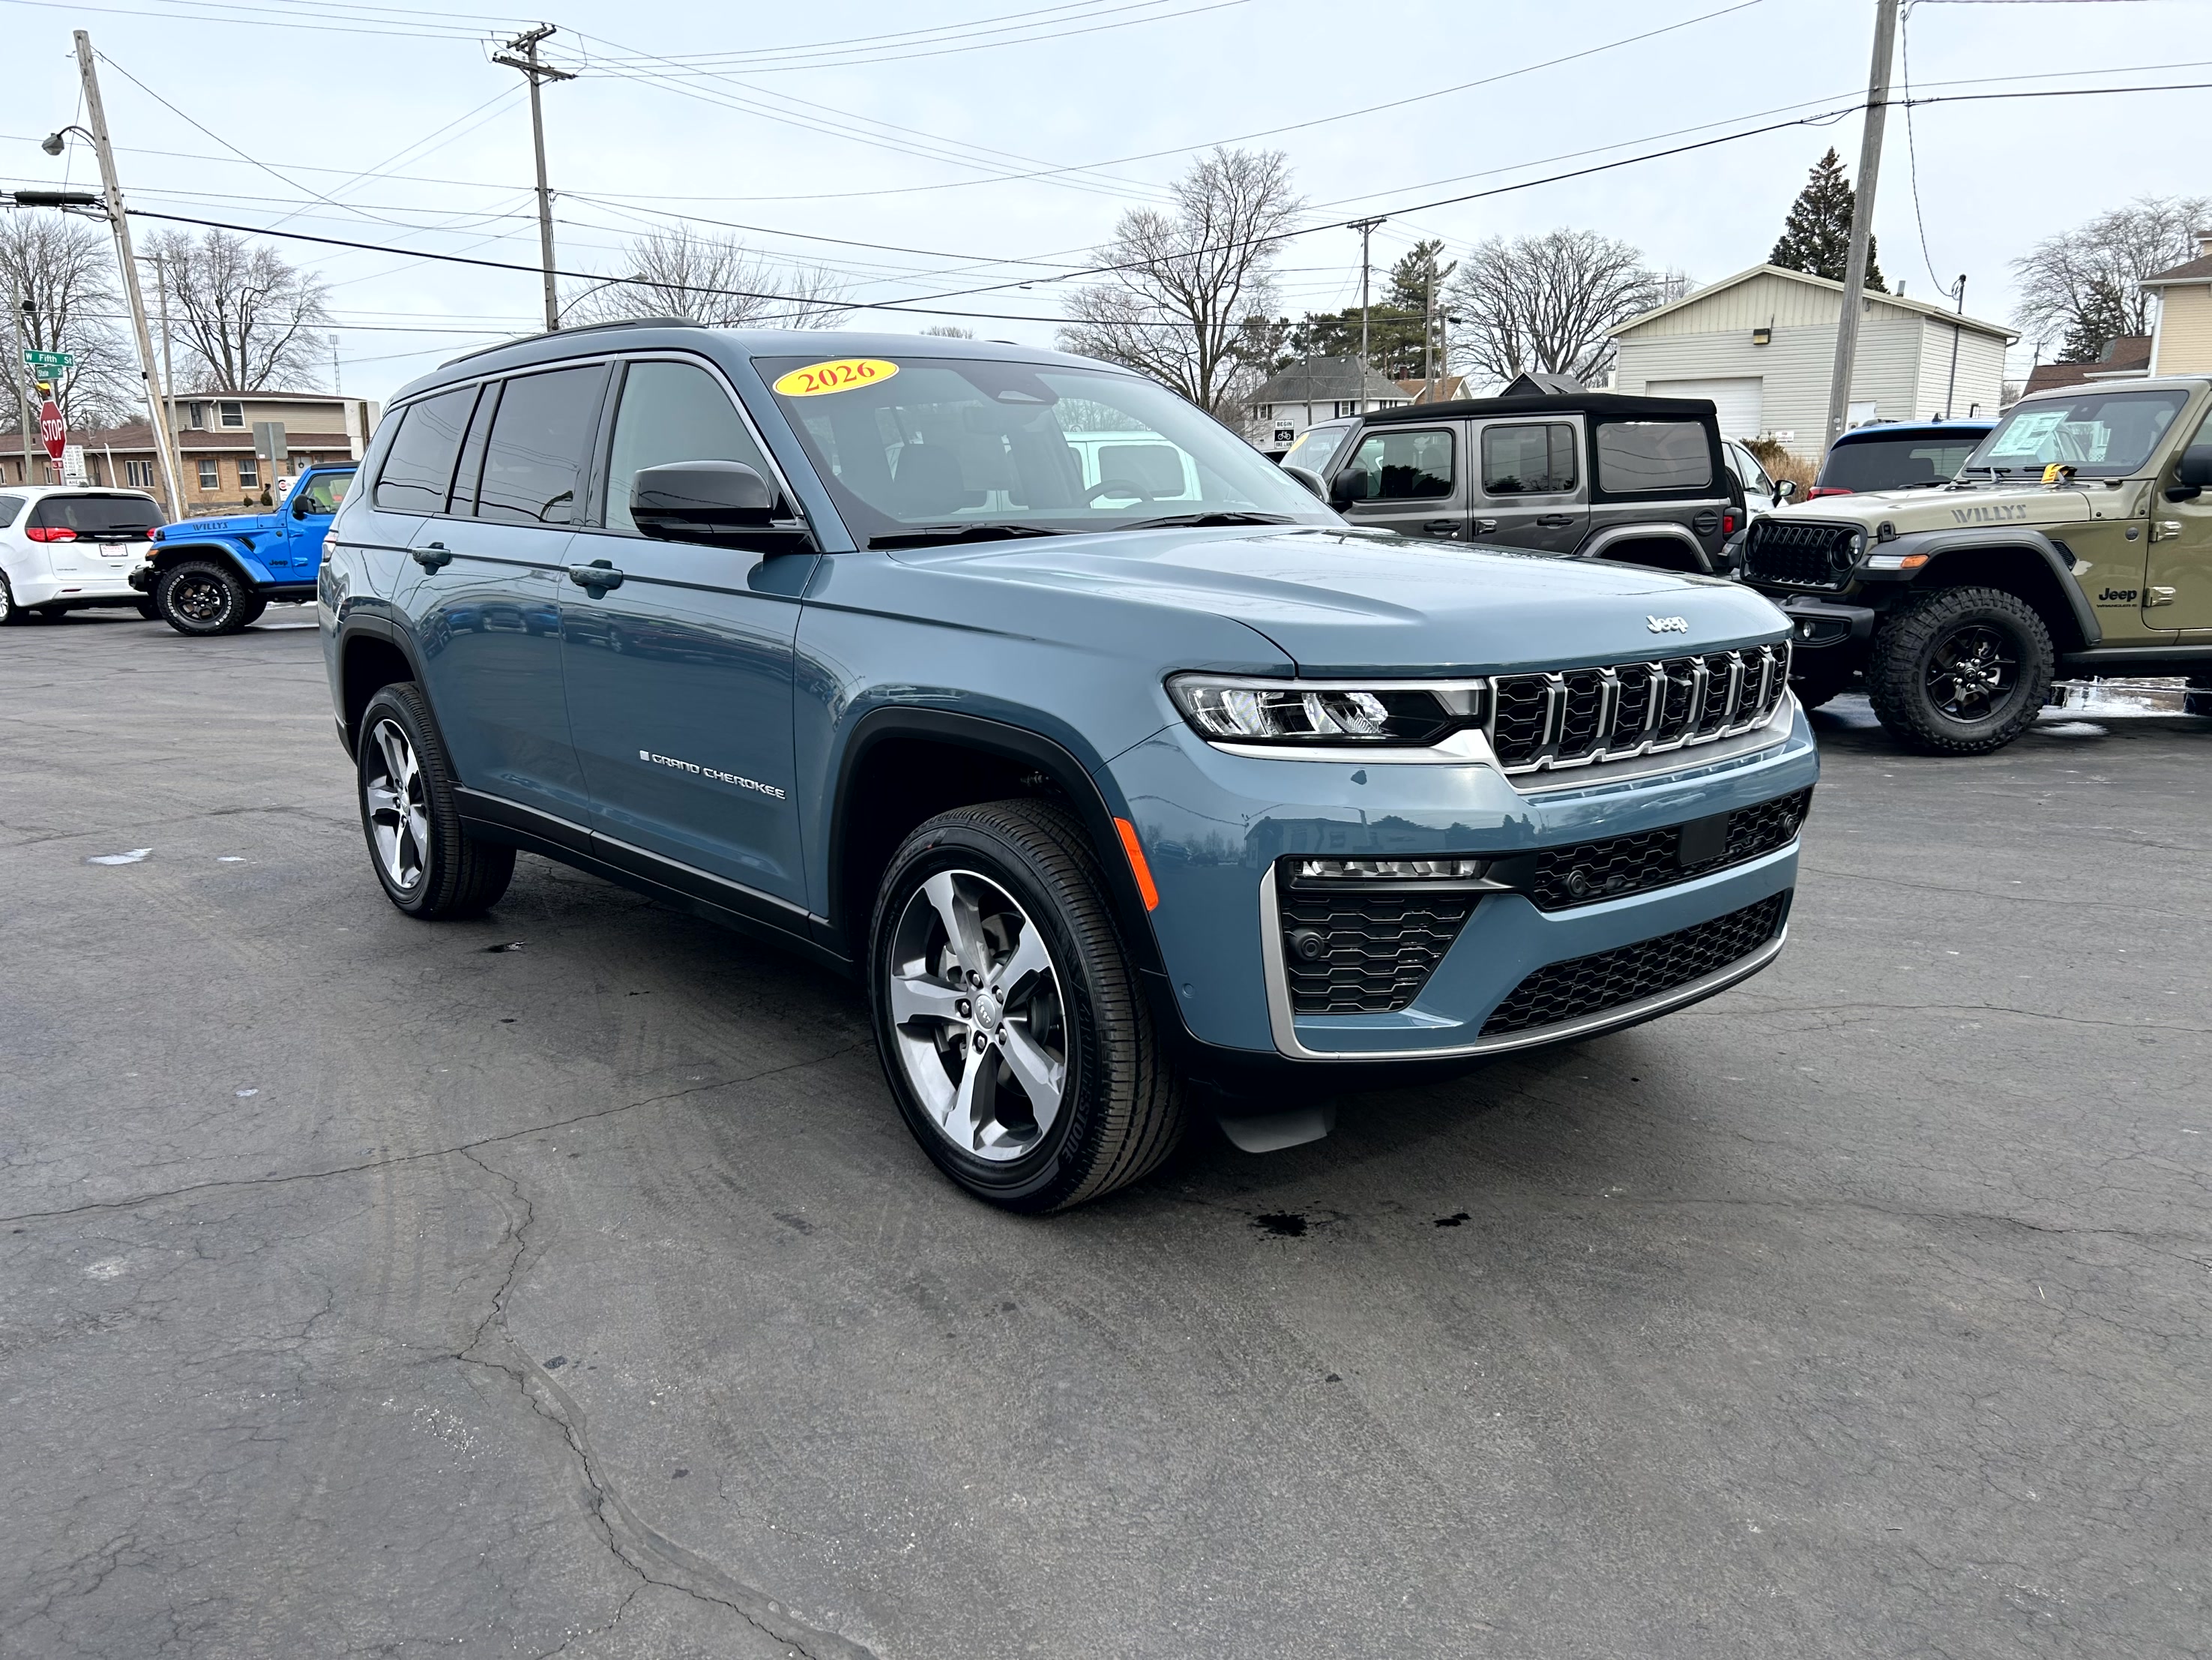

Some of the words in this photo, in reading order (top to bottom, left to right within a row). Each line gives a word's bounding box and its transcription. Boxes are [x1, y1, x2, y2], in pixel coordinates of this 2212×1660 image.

[25, 352, 32, 361] W
[39, 354, 57, 363] Fifth
[64, 356, 73, 364] St
[37, 369, 49, 377] State
[798, 361, 876, 393] 2026
[42, 418, 63, 442] STOP
[1950, 504, 2027, 523] WILLYS
[193, 521, 229, 531] WILLYS
[268, 559, 289, 567] Jeep
[2098, 587, 2138, 603] Jeep
[1645, 615, 1690, 634] Jeep
[651, 754, 702, 775] GRAND
[702, 767, 787, 800] CHEROKEE
[1060, 1005, 1094, 1164] BRIDGESTONE
